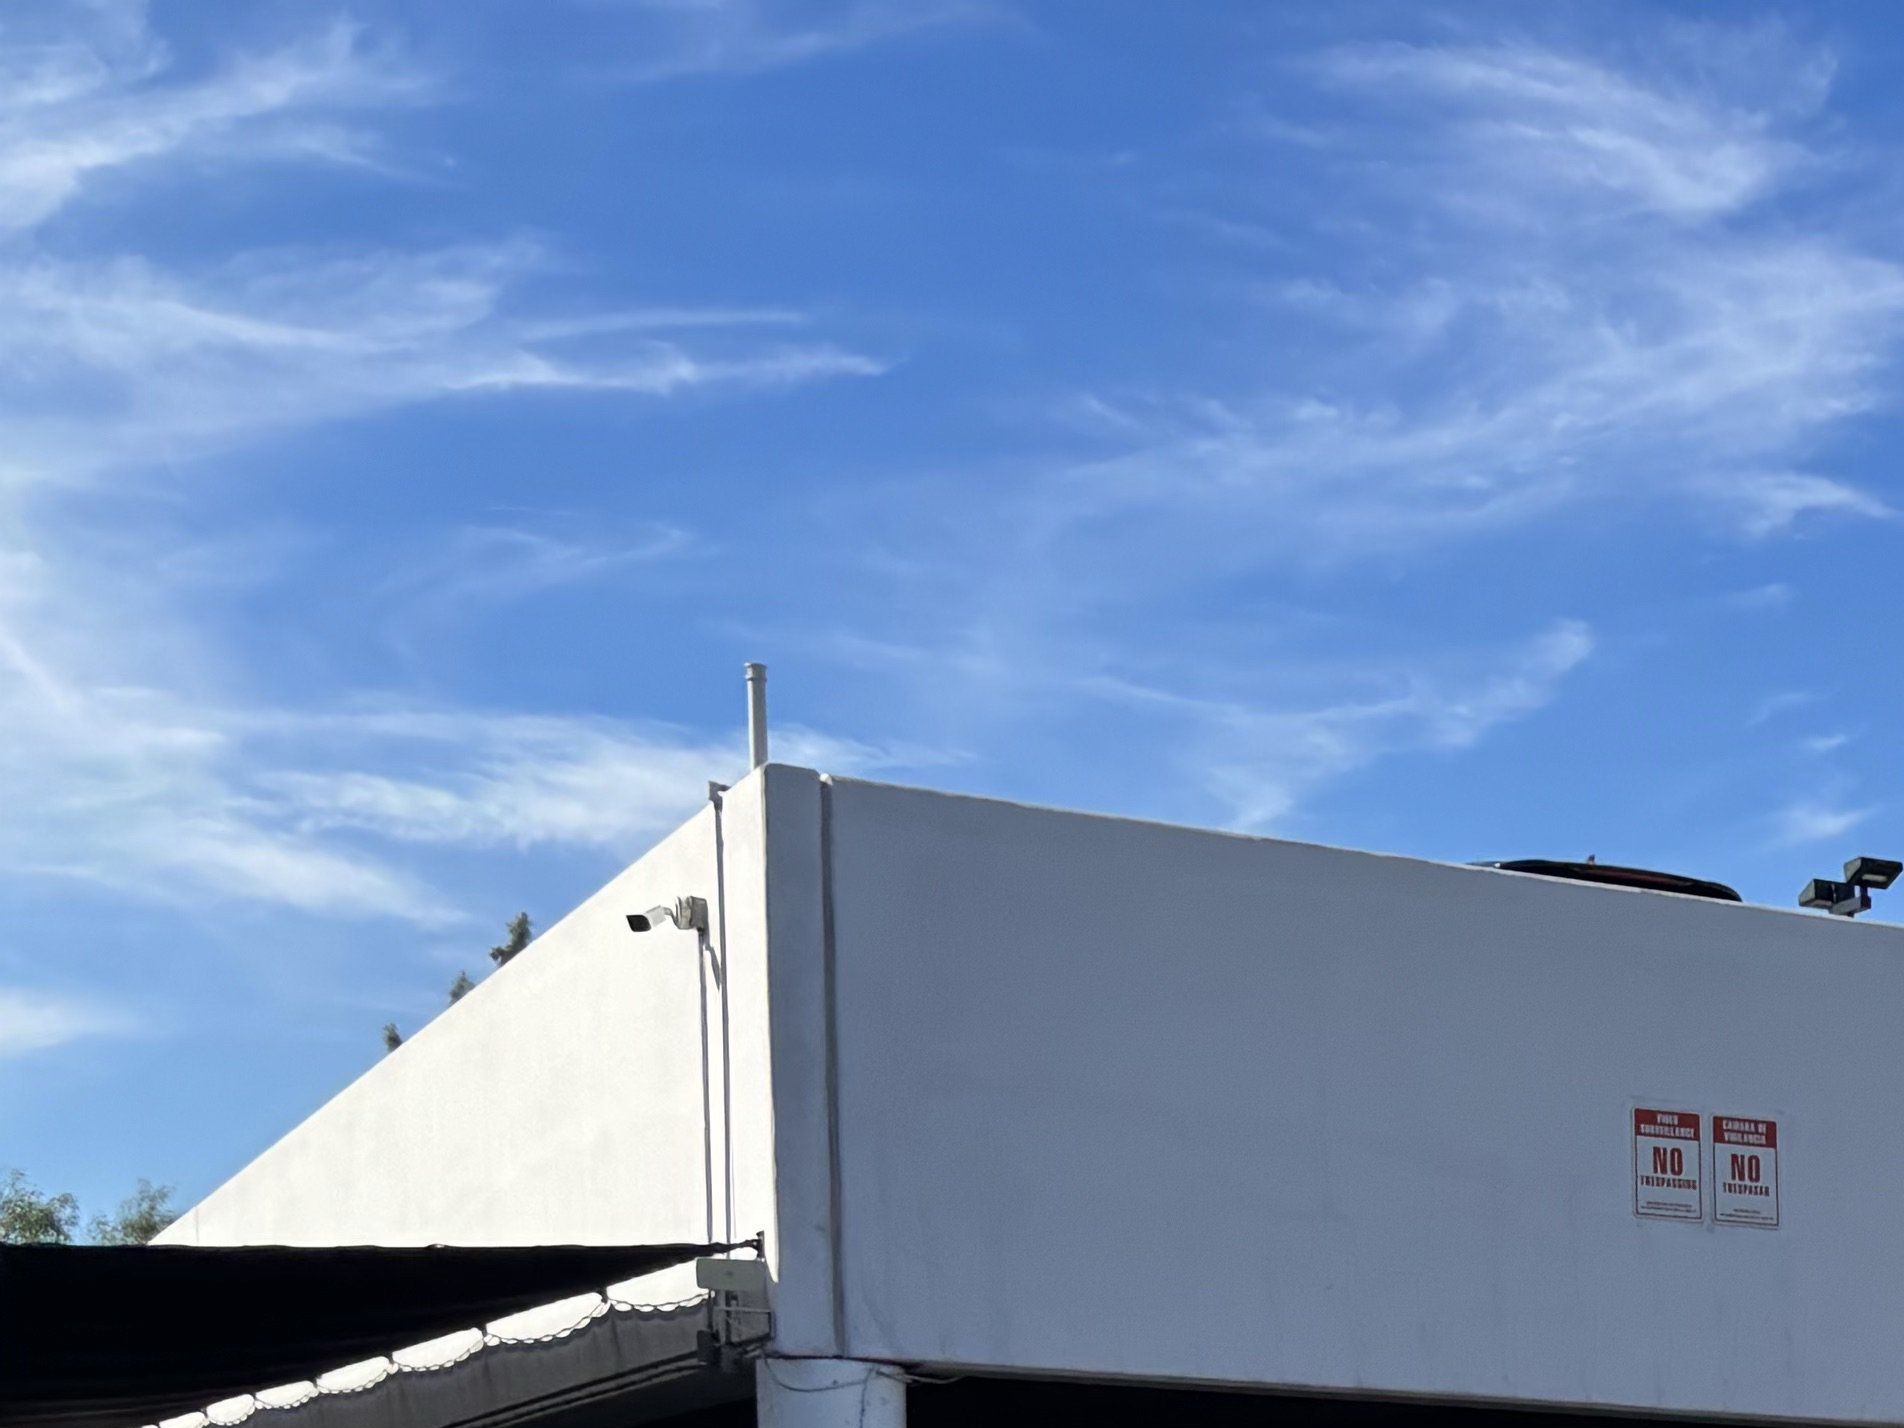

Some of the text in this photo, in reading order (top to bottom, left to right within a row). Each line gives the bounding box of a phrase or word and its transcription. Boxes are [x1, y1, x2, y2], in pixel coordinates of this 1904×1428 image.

[1652, 1146, 1684, 1176] NO
[1730, 1153, 1761, 1183] NO
[1640, 1174, 1698, 1190] TRESPASSING
